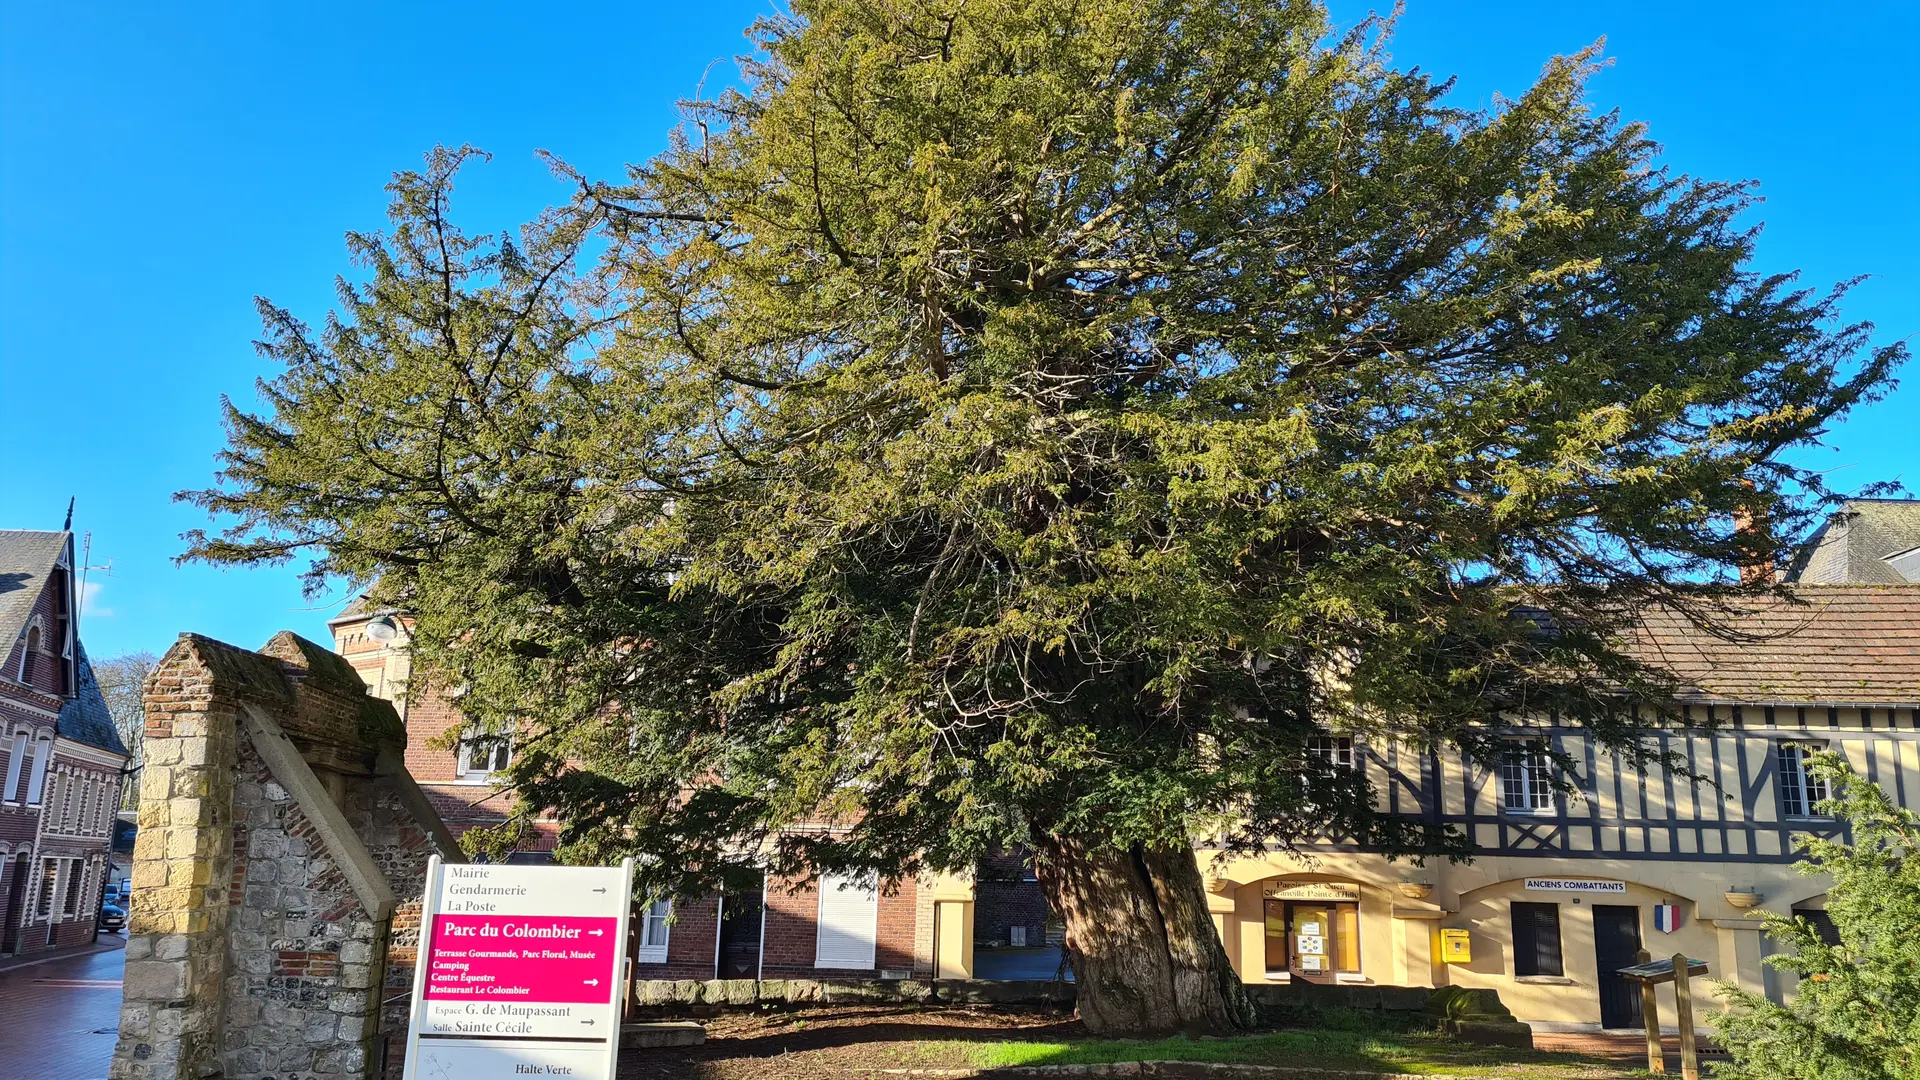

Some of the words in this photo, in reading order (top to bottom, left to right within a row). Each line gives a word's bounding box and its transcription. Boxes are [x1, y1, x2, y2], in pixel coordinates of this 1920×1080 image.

[451, 868, 490, 878] Mairie
[450, 884, 526, 896] Gendarmerie
[1564, 882, 1624, 890] COMBATTANTS
[448, 901, 462, 911] La
[465, 902, 496, 911] Poste
[444, 922, 476, 937] Parc
[480, 922, 498, 937] du
[503, 923, 581, 938] Colombier
[434, 949, 467, 957] Terrasse
[469, 950, 519, 959] Gourmande,
[542, 950, 568, 959] Floral,
[570, 951, 595, 959] Musée
[433, 961, 469, 971] Camping
[431, 973, 458, 982] Centre
[460, 972, 495, 983] Équestre
[430, 986, 473, 994] Restaurant
[487, 986, 530, 995] Colombier
[435, 1007, 462, 1016] Espace
[466, 1004, 479, 1015] G.
[482, 1004, 496, 1015] de
[500, 1004, 570, 1019] Maupassant
[433, 1023, 452, 1032] Salle
[455, 1021, 492, 1033] Sainte
[496, 1021, 532, 1033] Cécile
[516, 1064, 542, 1074] Halte
[546, 1065, 571, 1075] Verte
